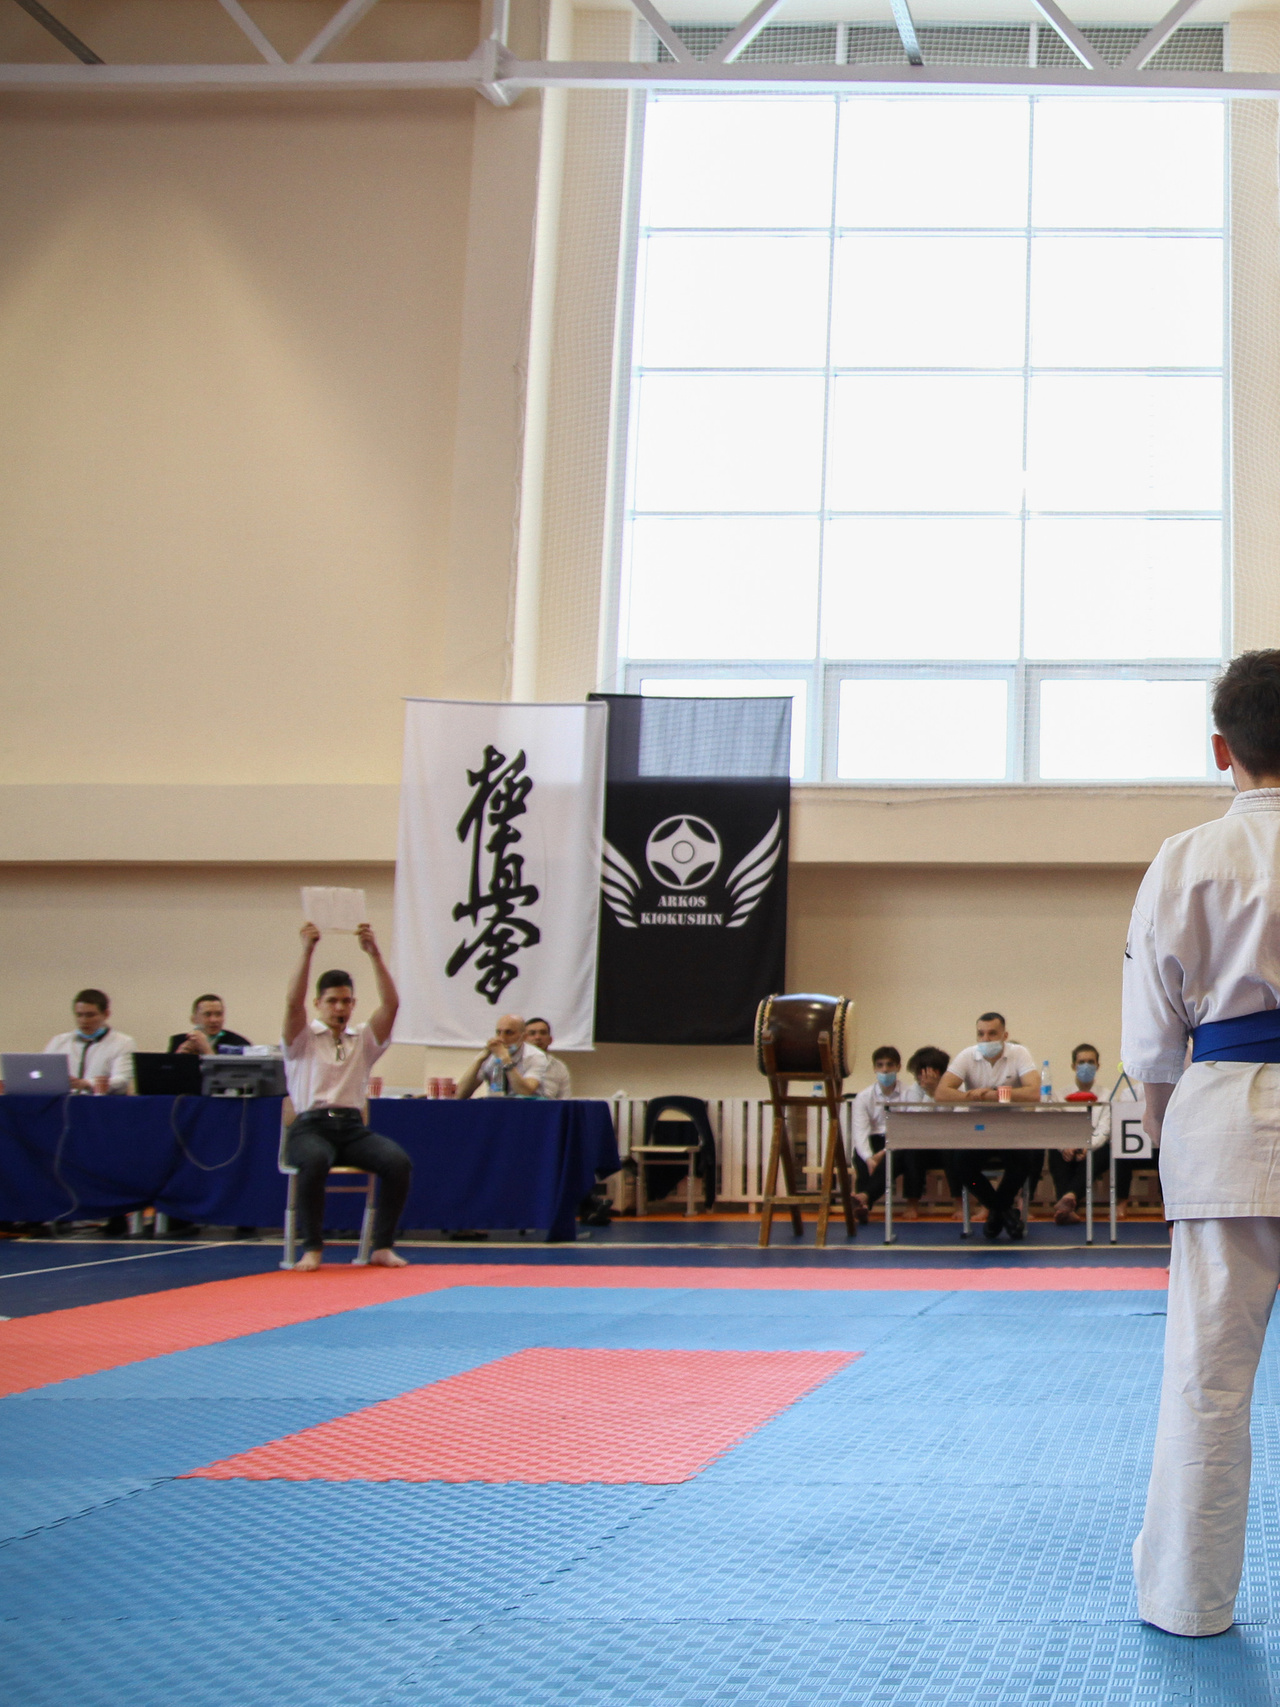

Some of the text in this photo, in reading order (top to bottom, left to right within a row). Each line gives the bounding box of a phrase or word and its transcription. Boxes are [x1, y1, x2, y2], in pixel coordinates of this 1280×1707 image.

[657, 895, 708, 908] ARKOS
[640, 912, 724, 926] KIOKUSHIN
[1121, 1119, 1144, 1154] Б
